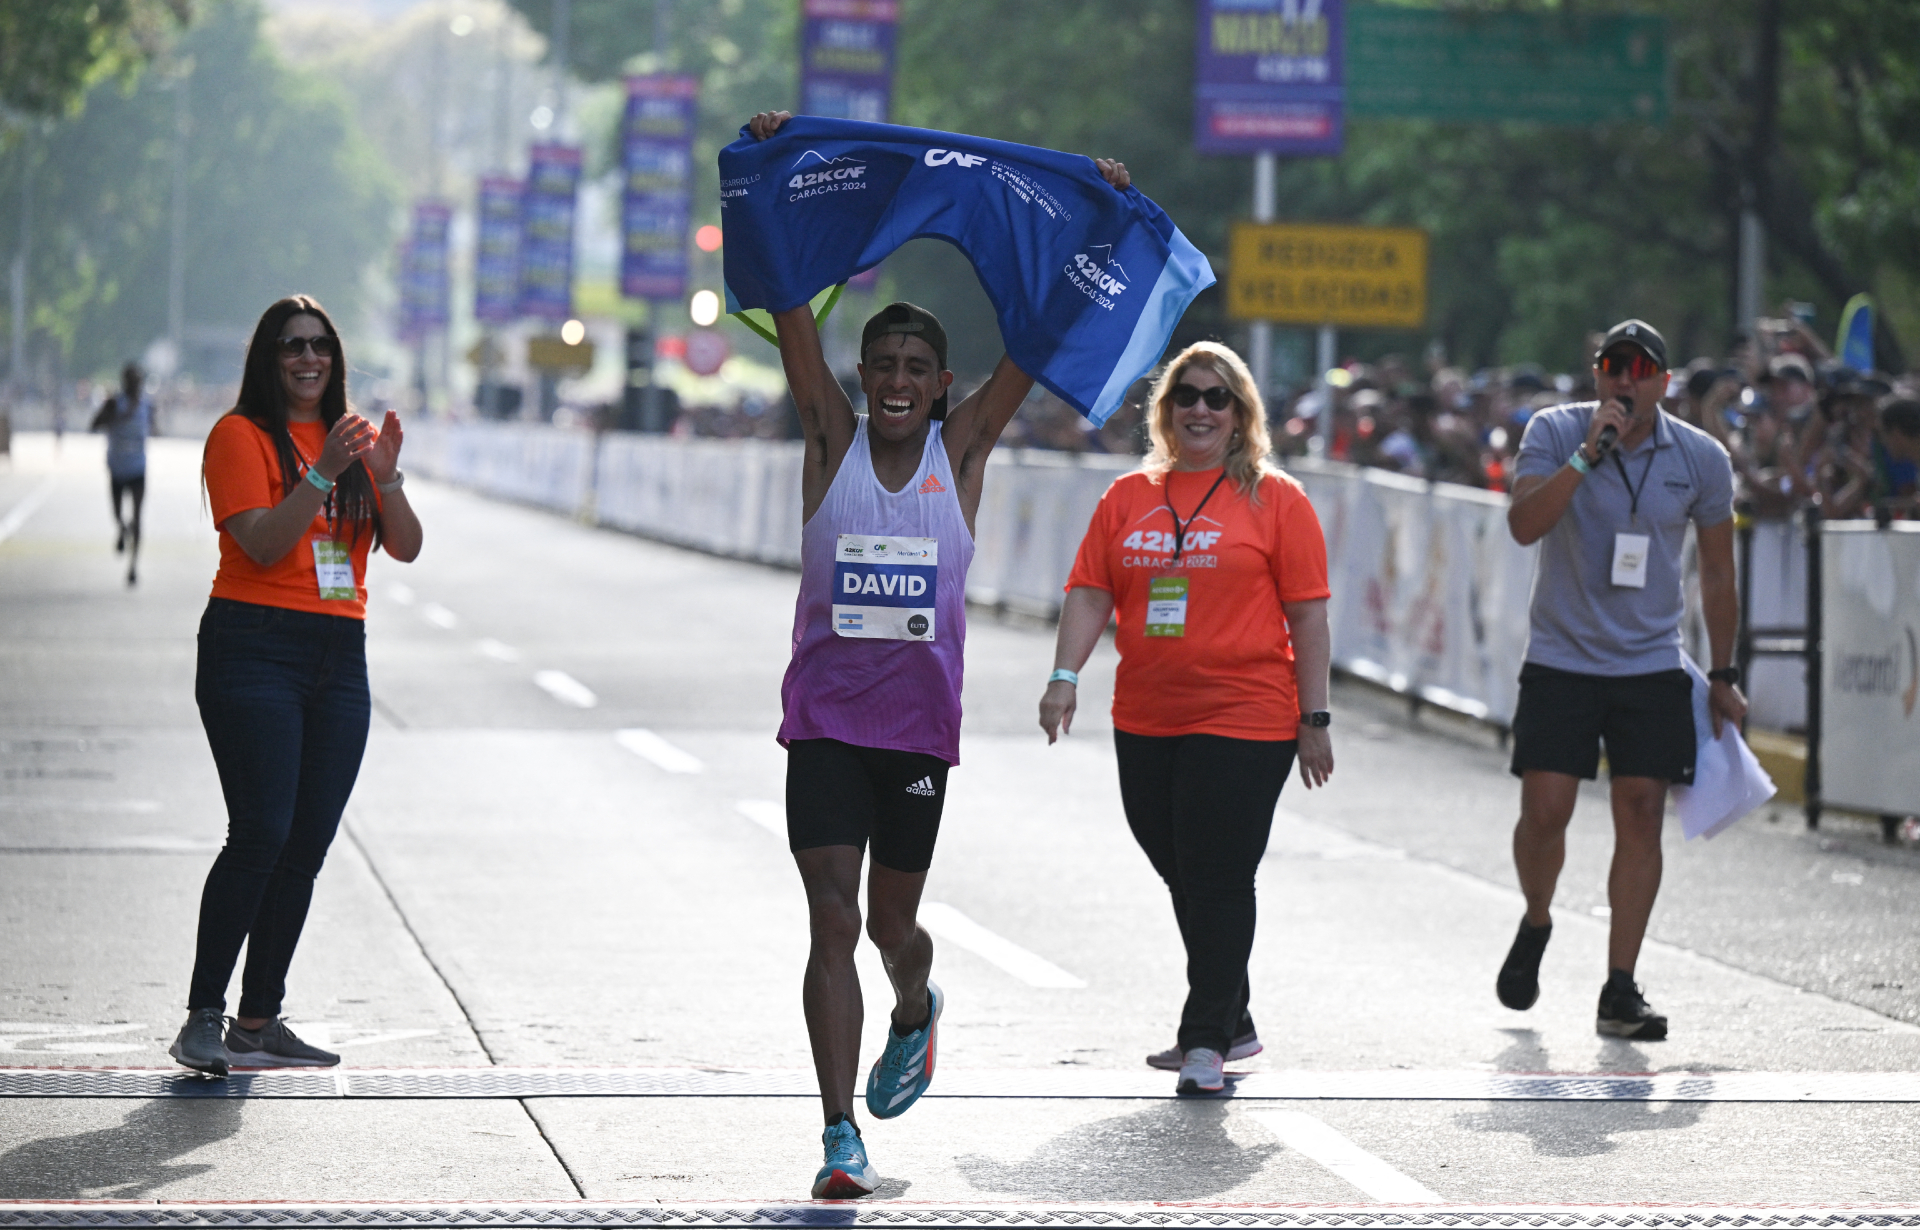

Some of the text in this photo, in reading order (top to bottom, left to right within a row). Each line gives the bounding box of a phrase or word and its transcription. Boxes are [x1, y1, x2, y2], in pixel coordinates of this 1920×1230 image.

[924, 148, 988, 168] CAF
[789, 182, 867, 203] CARACAS 2024
[991, 165, 1057, 220] DE AMÉRICA LATINA
[992, 160, 1072, 222] BANCO DE DESARROLLO
[997, 173, 1007, 182] EL
[1007, 180, 1031, 204] CARIBE
[1260, 238, 1398, 269] REDUZCA
[1064, 264, 1115, 311] CARACAS 2024
[1238, 278, 1416, 310] VELOCIDAD
[918, 486, 946, 494] adidas
[843, 572, 926, 597] DAVID
[905, 786, 936, 796] adidas
